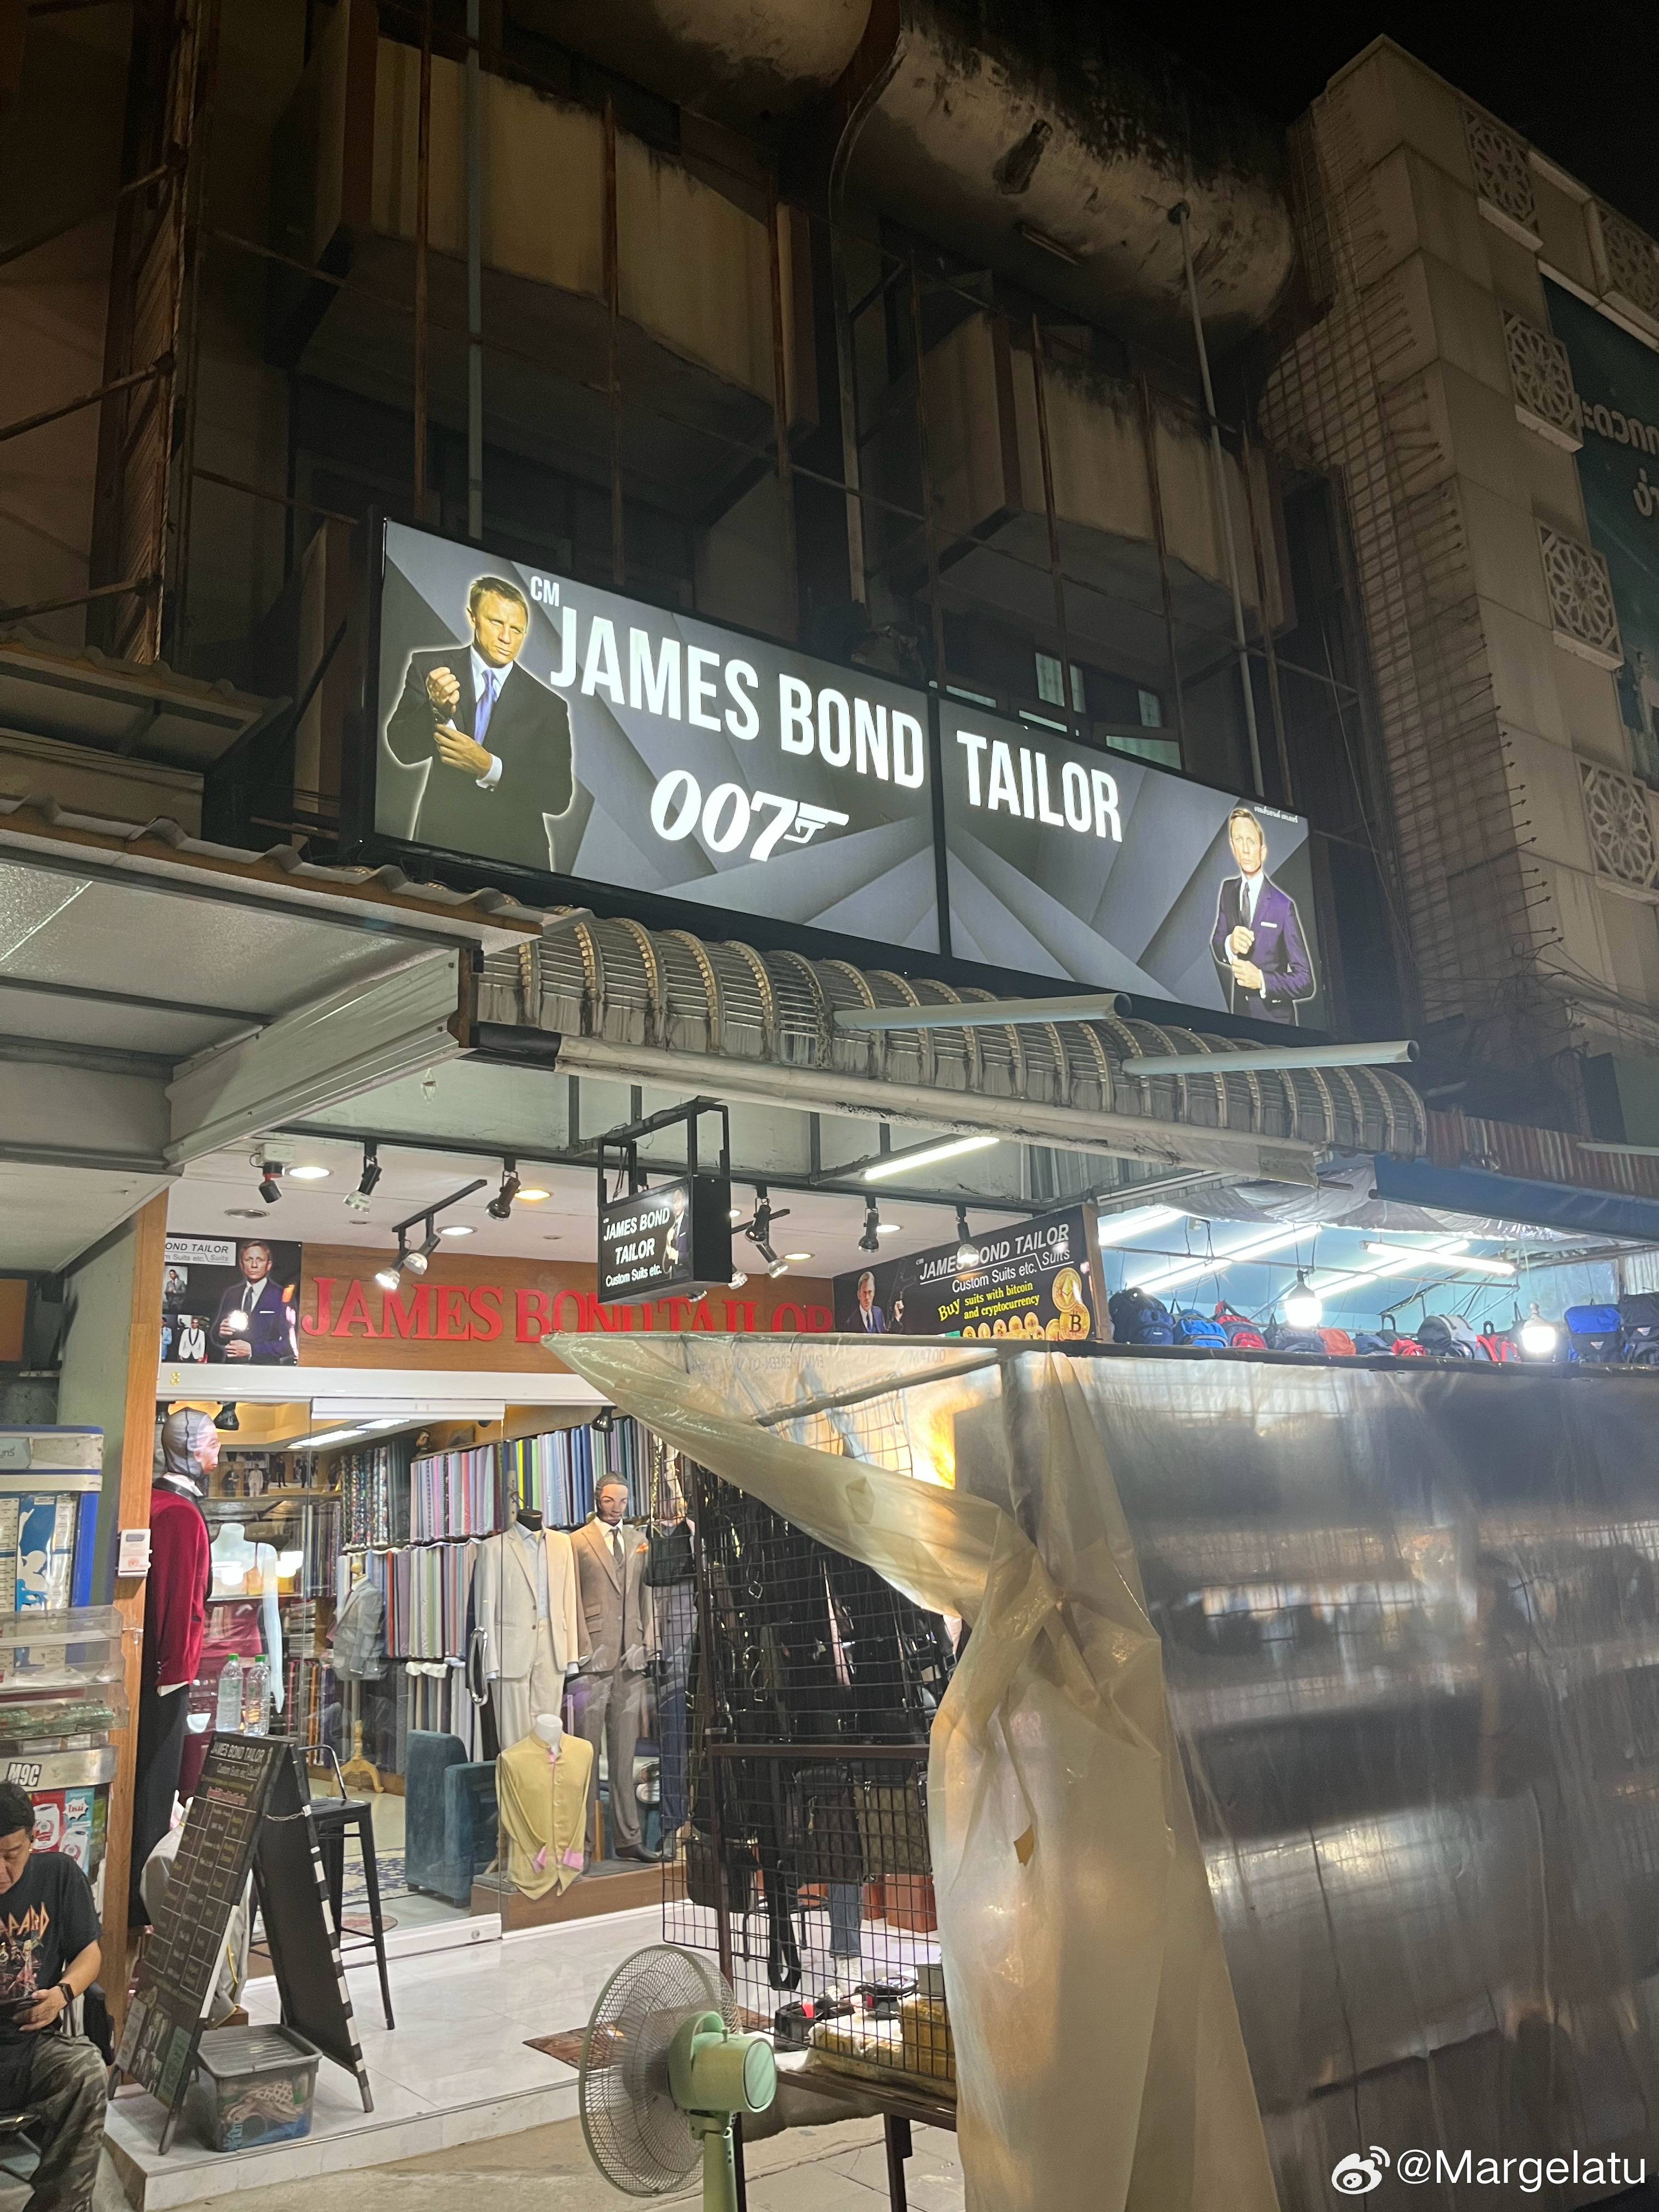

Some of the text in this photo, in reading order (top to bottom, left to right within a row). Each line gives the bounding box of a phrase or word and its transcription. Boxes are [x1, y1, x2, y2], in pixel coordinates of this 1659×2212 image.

[531, 575, 560, 607] CM
[550, 606, 1122, 843] JAMES BOND TAILOR
[650, 770, 798, 862] 007
[603, 1207, 670, 1241] JAMES BOND
[1015, 1223, 1069, 1255] TAILOR
[165, 1242, 229, 1254] OND TAILOR
[615, 1238, 656, 1265] TAILOR
[606, 1263, 663, 1287] Custom Suits etc.
[952, 1249, 1070, 1293] Custom Suits etc. Suits
[302, 1277, 504, 1341] JAMES
[938, 1280, 1034, 1322] Buy suits with bitcoin
[963, 1295, 1040, 1320] and cryptocurrency
[8, 1763, 40, 1786] M9C
